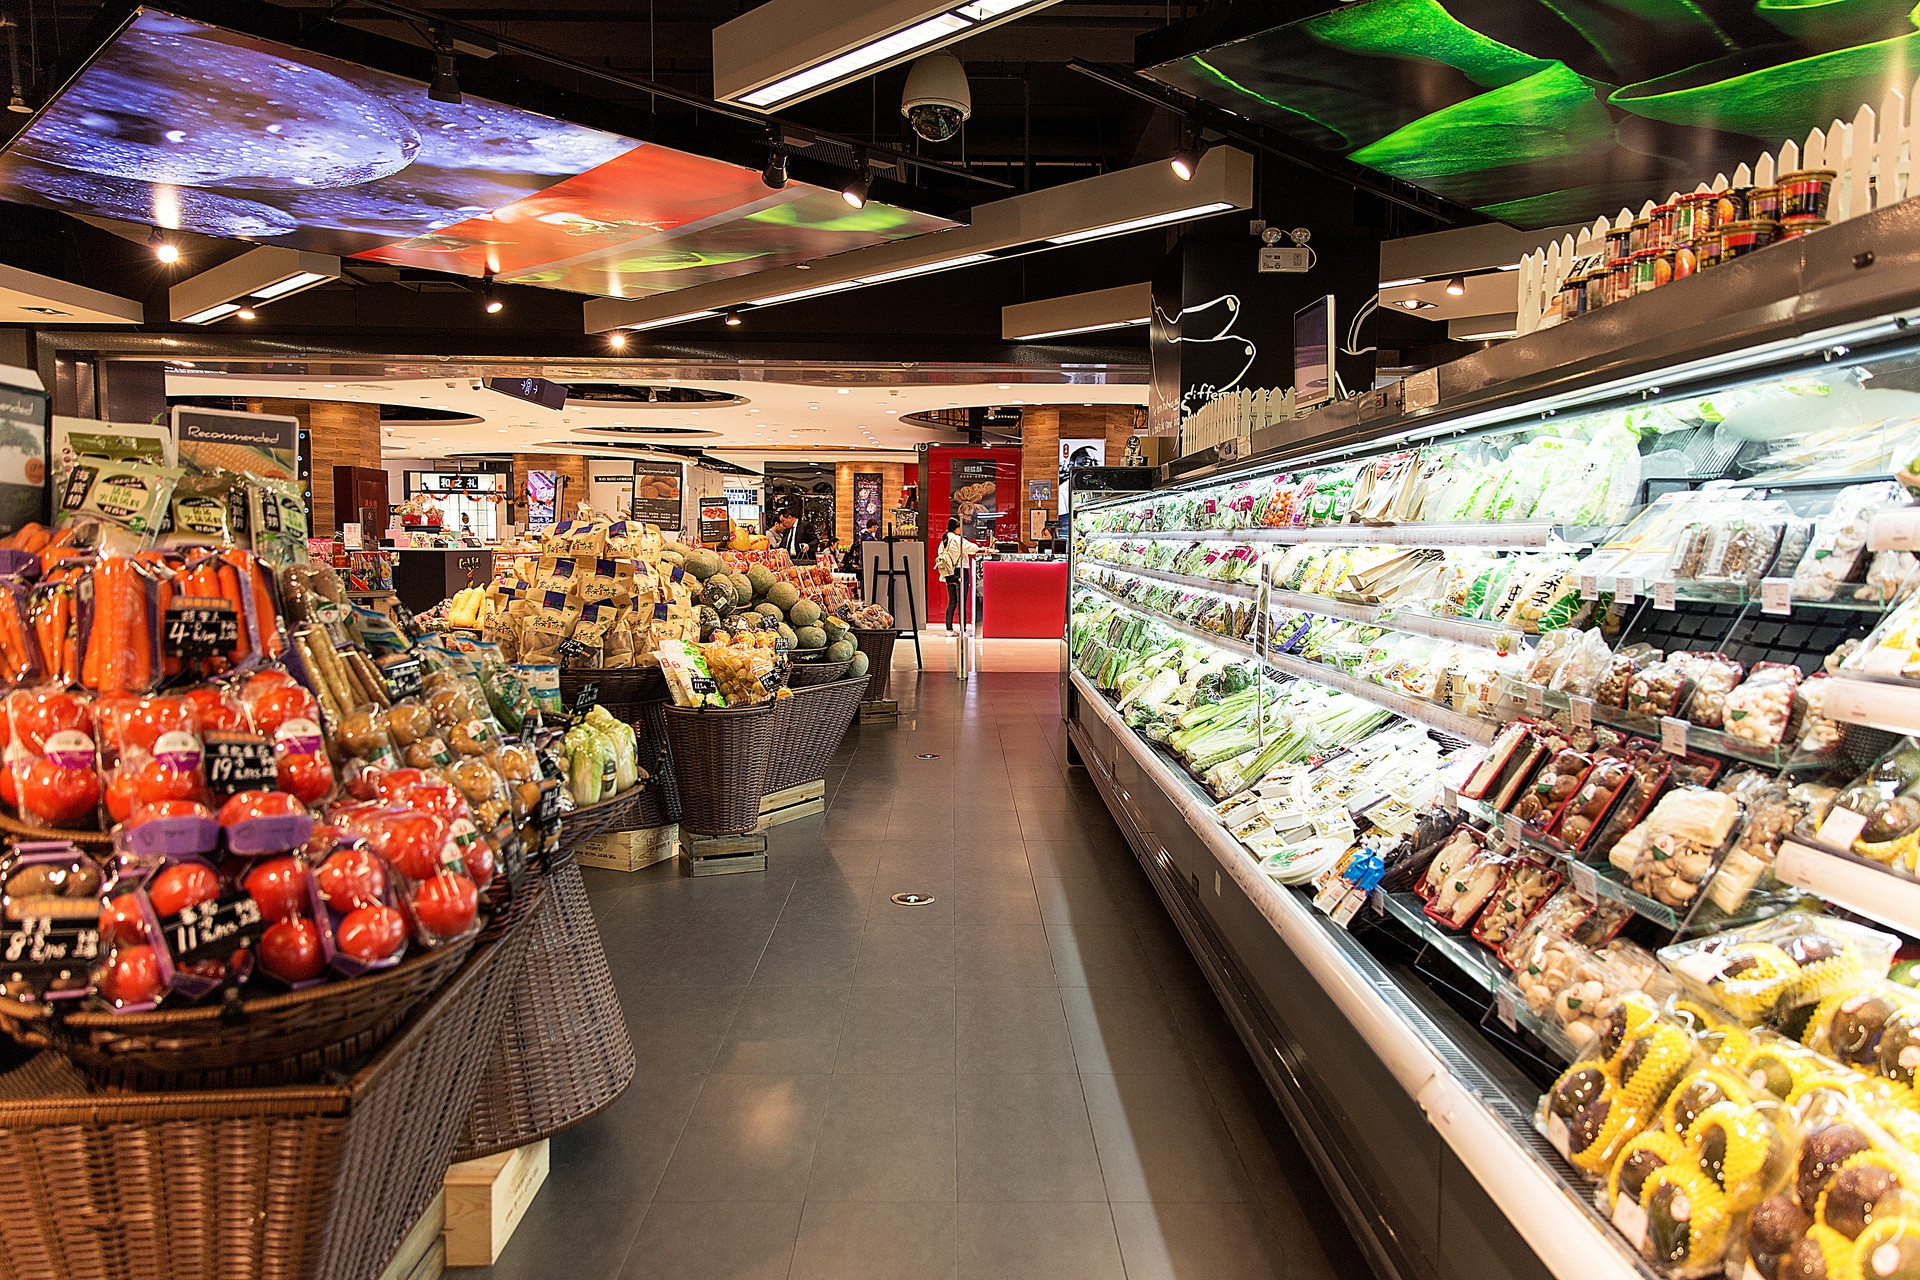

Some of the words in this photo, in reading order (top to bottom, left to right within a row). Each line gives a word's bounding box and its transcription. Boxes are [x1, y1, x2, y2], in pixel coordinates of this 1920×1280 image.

[187, 425, 280, 444] Recommended
[638, 467, 677, 475] Recommended
[440, 477, 478, 489] 和之礼
